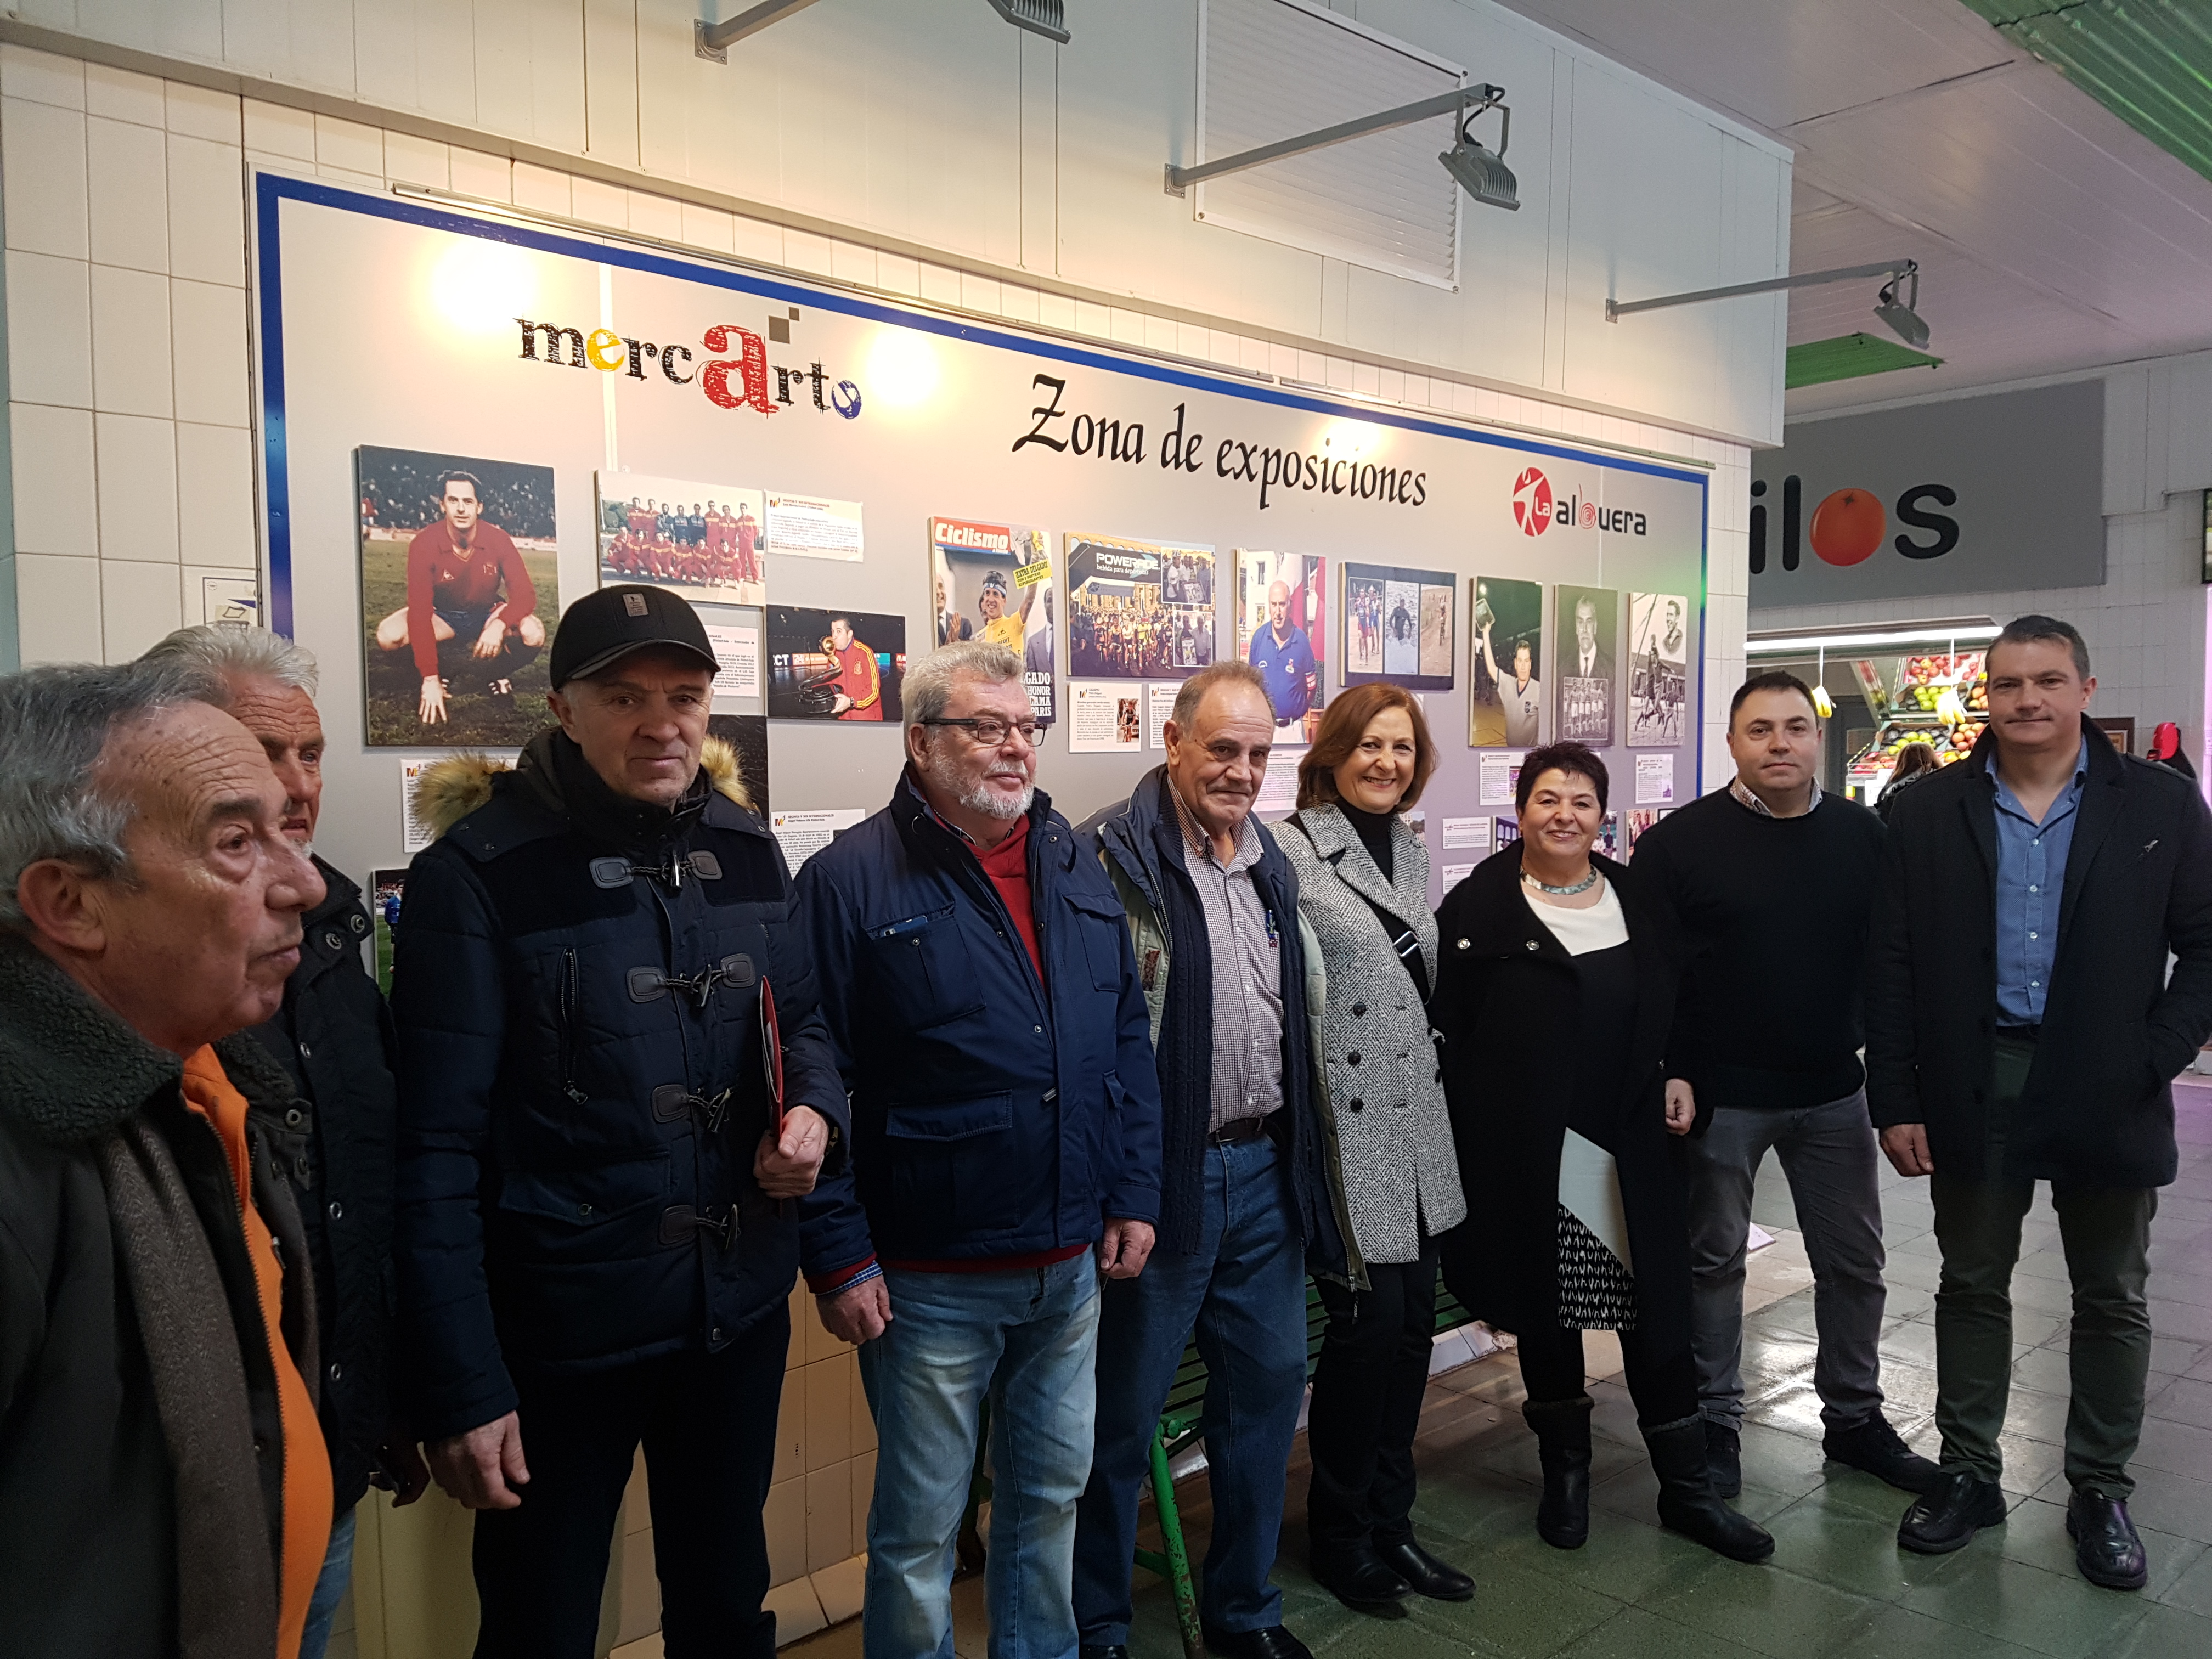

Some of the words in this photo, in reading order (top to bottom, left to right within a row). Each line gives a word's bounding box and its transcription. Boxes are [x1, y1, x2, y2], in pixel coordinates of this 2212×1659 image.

[1012, 374, 1147, 464] Zona
[1161, 403, 1203, 472] de
[1216, 438, 1426, 510] exposiciones
[935, 522, 1009, 549] Ciclismo
[1097, 563, 1113, 572] bebida
[1028, 686, 1051, 696] HONOR
